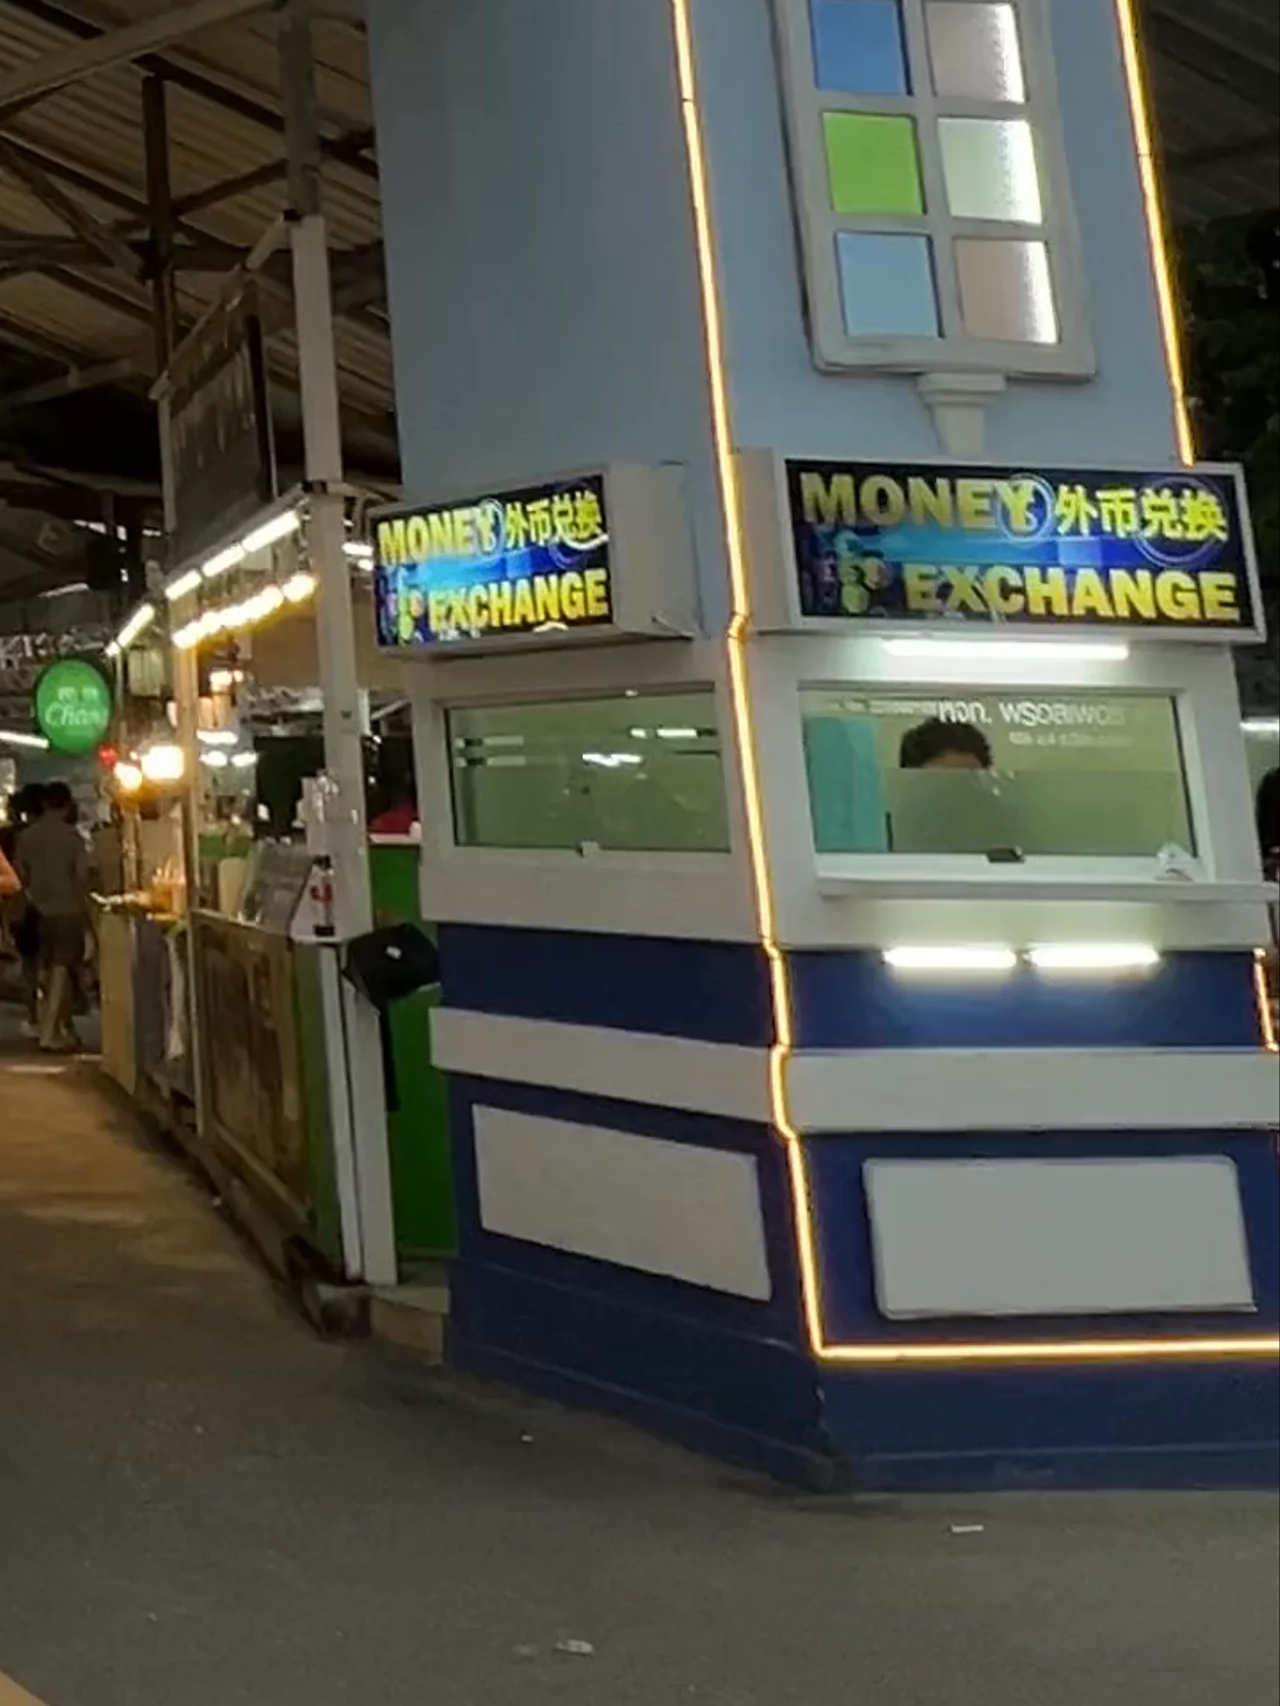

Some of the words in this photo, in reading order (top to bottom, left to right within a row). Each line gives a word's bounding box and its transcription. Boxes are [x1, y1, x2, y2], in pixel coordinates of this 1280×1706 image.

[377, 501, 497, 565] MONEY
[503, 490, 603, 547] 外币兑换
[800, 471, 1040, 532] MONEY
[1054, 483, 1228, 544] 外币兑换
[428, 568, 609, 633] EXCHANGE
[904, 563, 1240, 622] EXCHANGE
